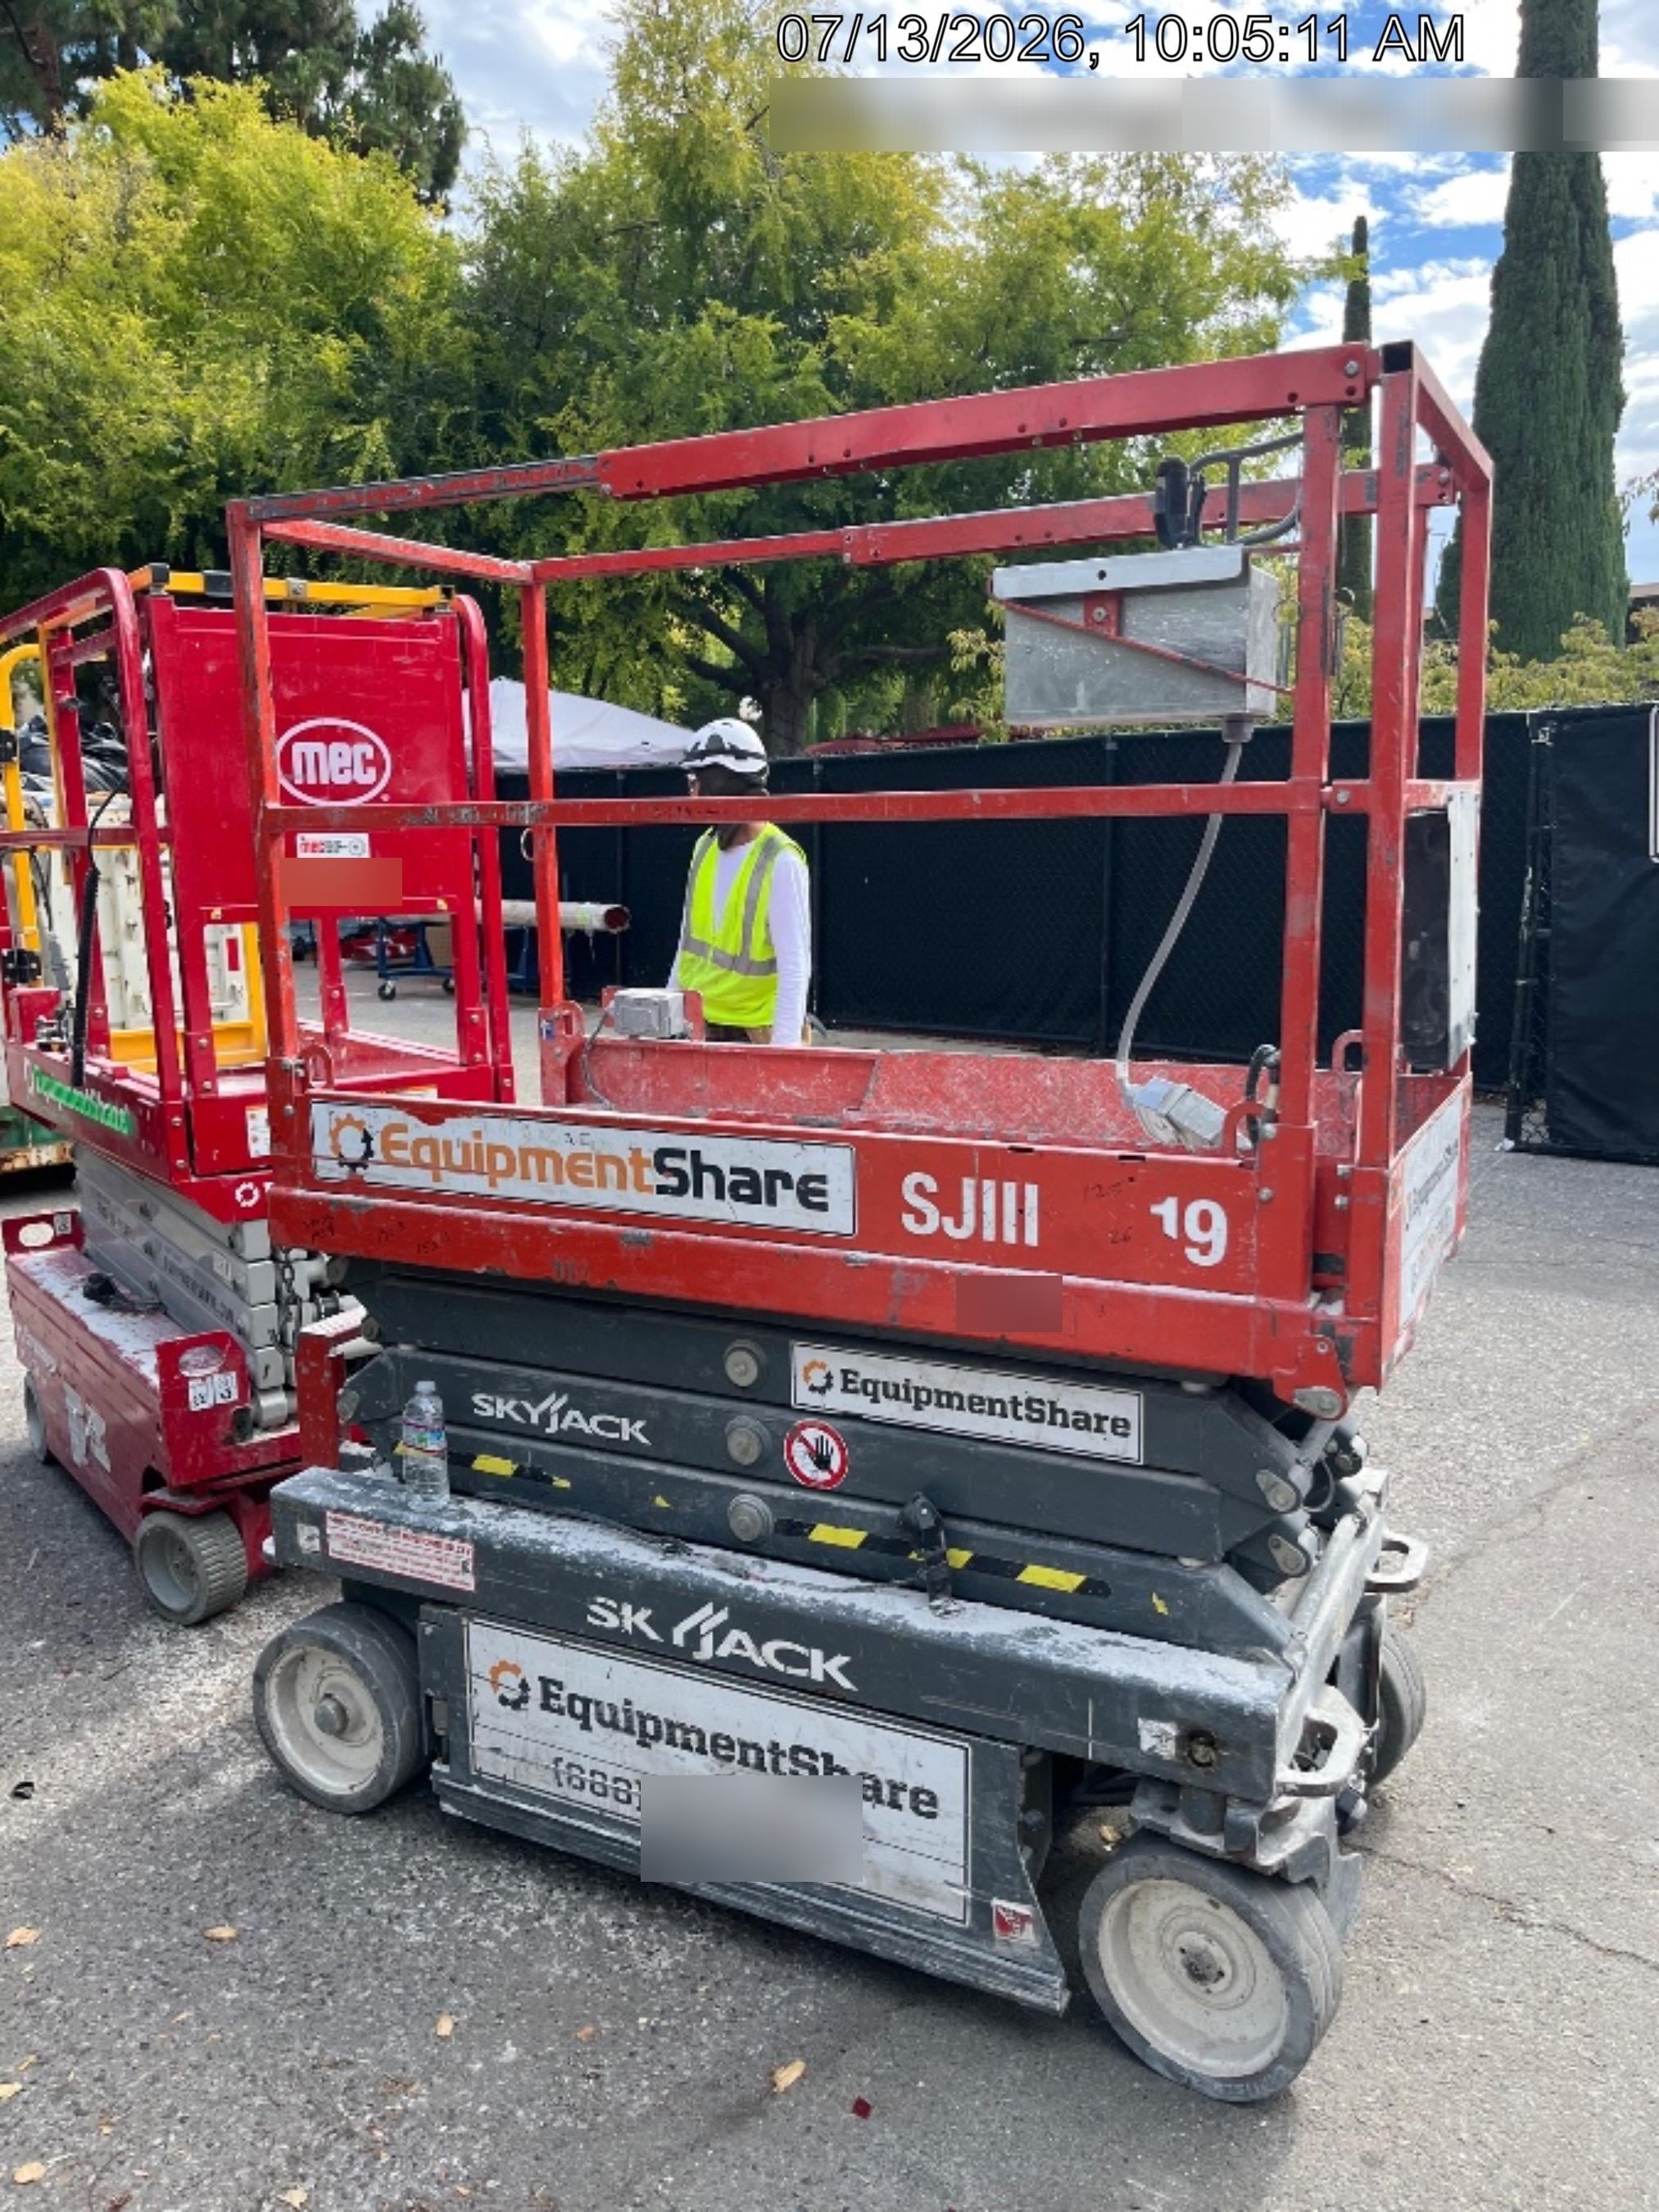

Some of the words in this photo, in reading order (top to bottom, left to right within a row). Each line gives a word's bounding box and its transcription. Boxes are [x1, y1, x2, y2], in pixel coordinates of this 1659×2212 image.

[380, 1122, 829, 1213] EquipmentShare
[1149, 1196, 1229, 1267] 19
[471, 1390, 652, 1447] SKYJACK
[840, 1367, 1132, 1439] EquipmentShare
